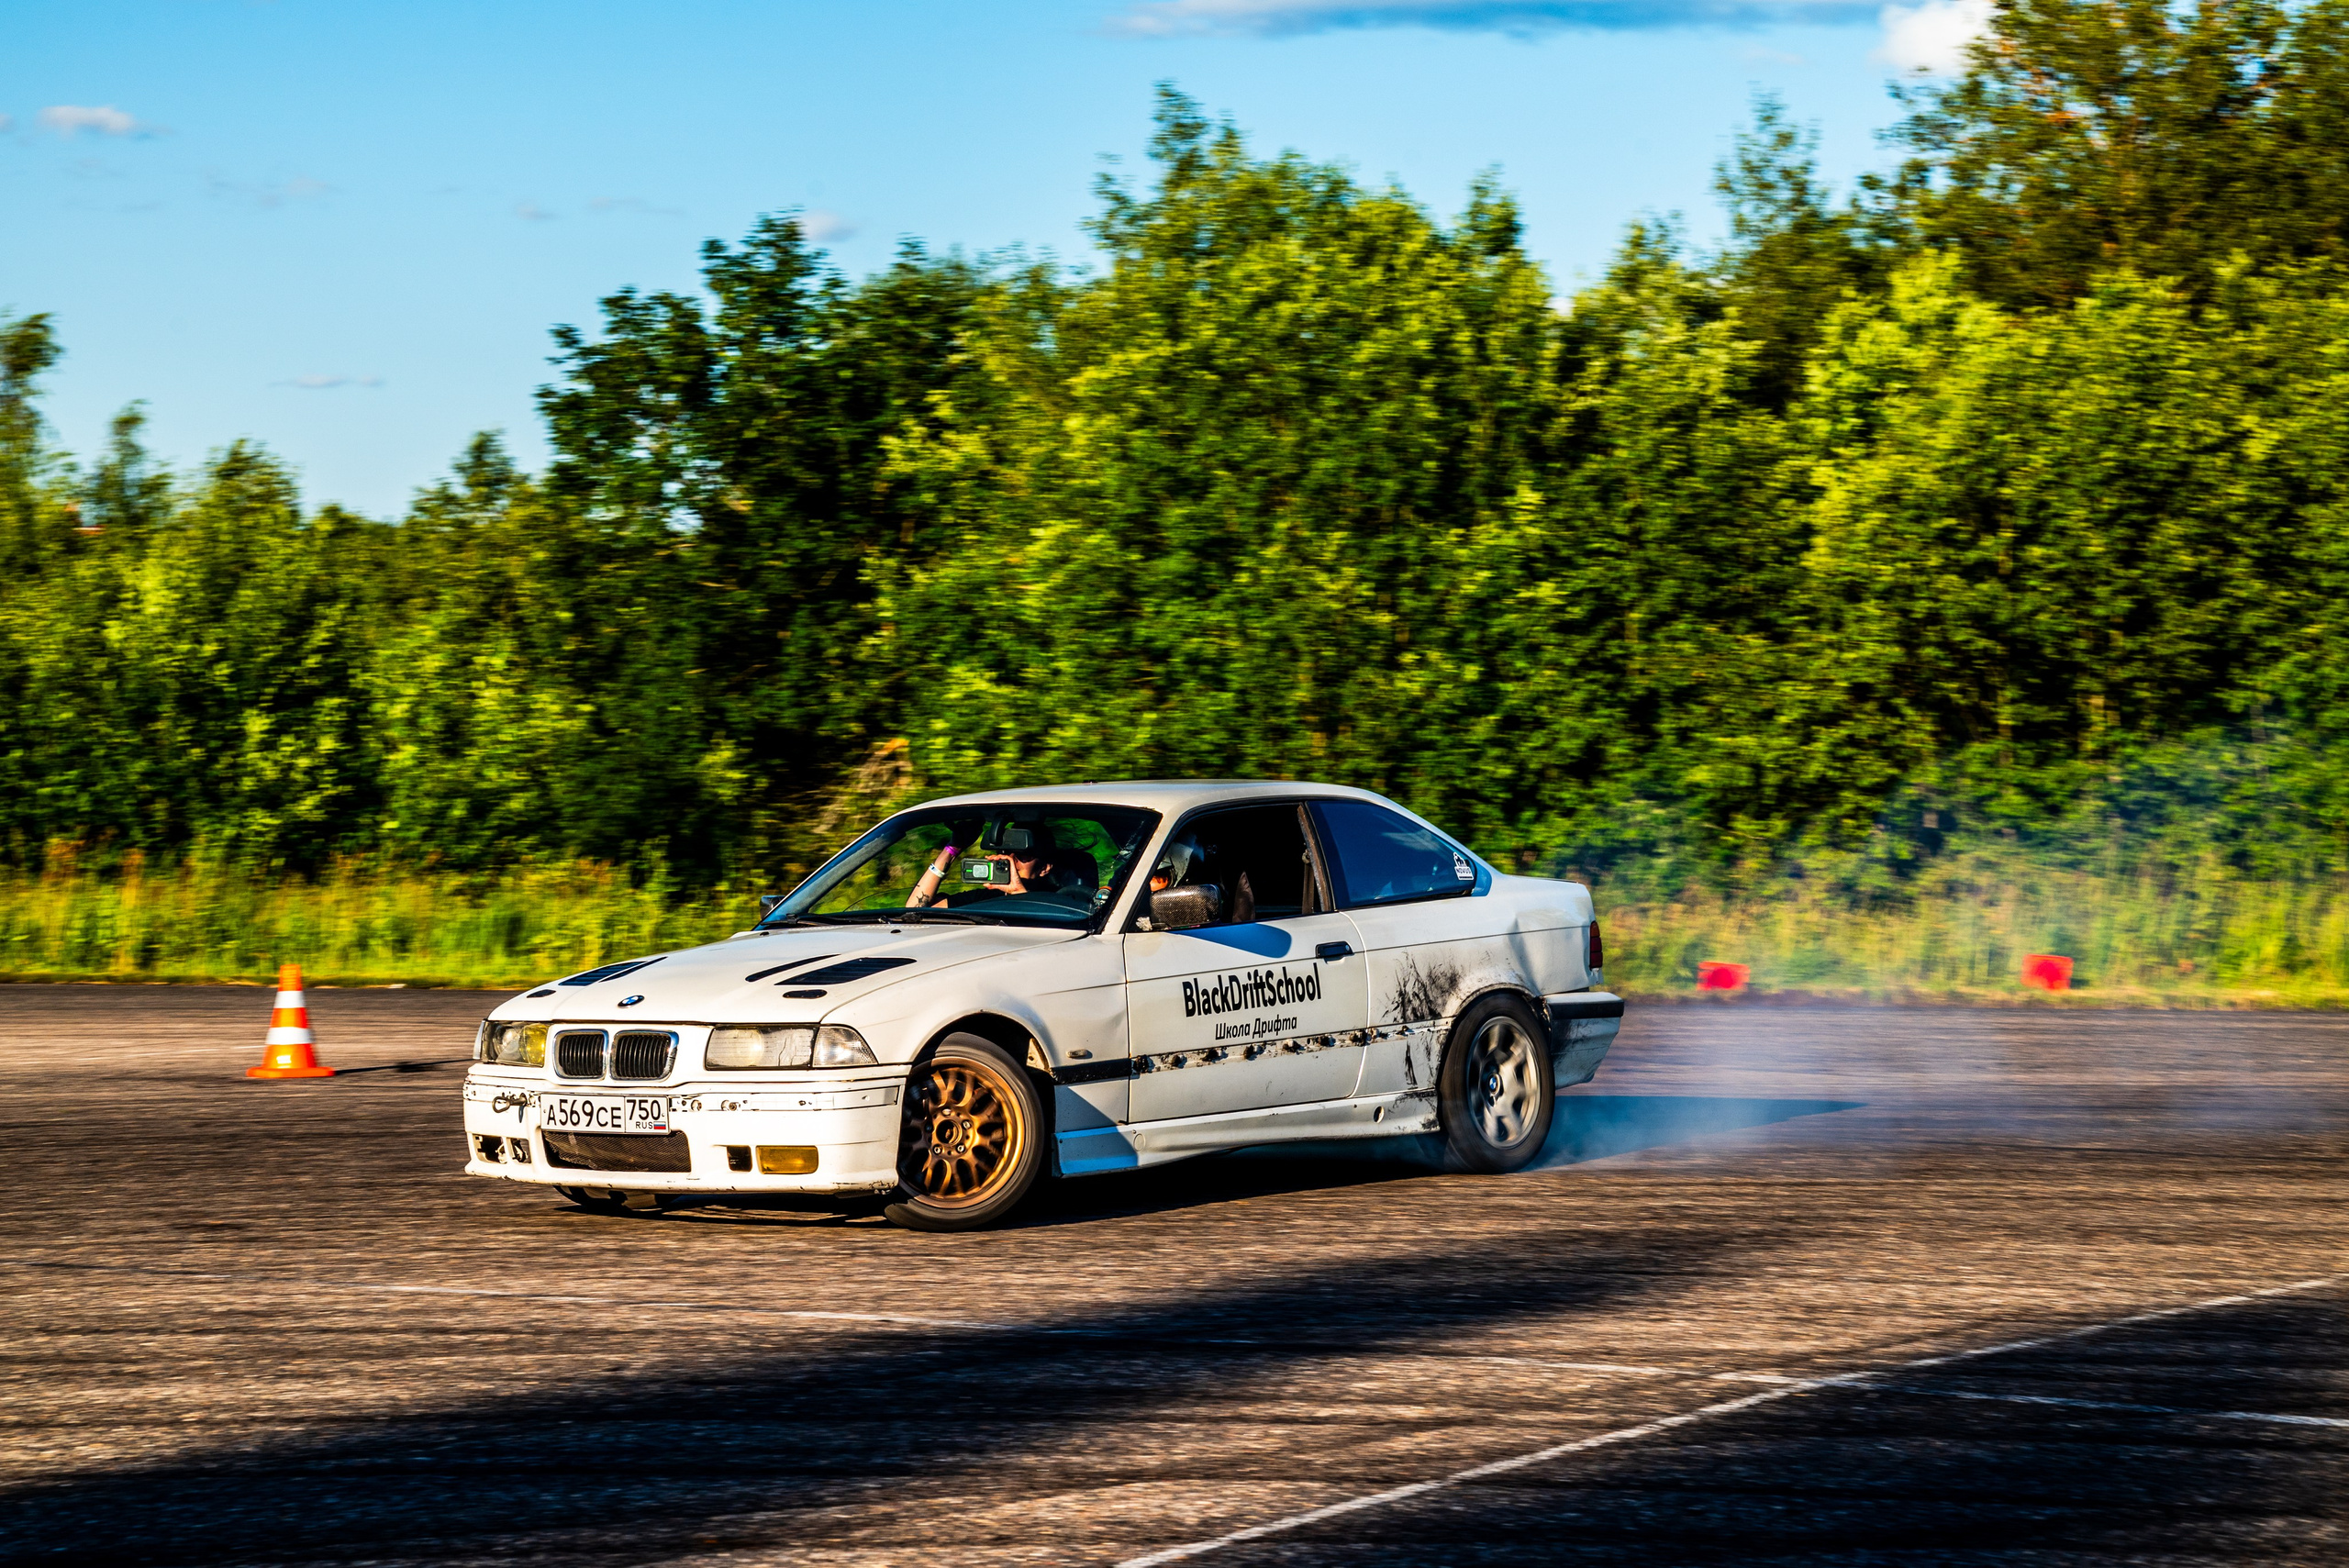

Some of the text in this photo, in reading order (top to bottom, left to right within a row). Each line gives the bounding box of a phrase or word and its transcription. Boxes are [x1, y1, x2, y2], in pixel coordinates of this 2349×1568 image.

[1182, 962, 1321, 1018] BlackDriftSchool
[1215, 1014, 1297, 1040] Школа Дрифта
[627, 1099, 661, 1120] 750
[635, 1121, 653, 1129] RUS
